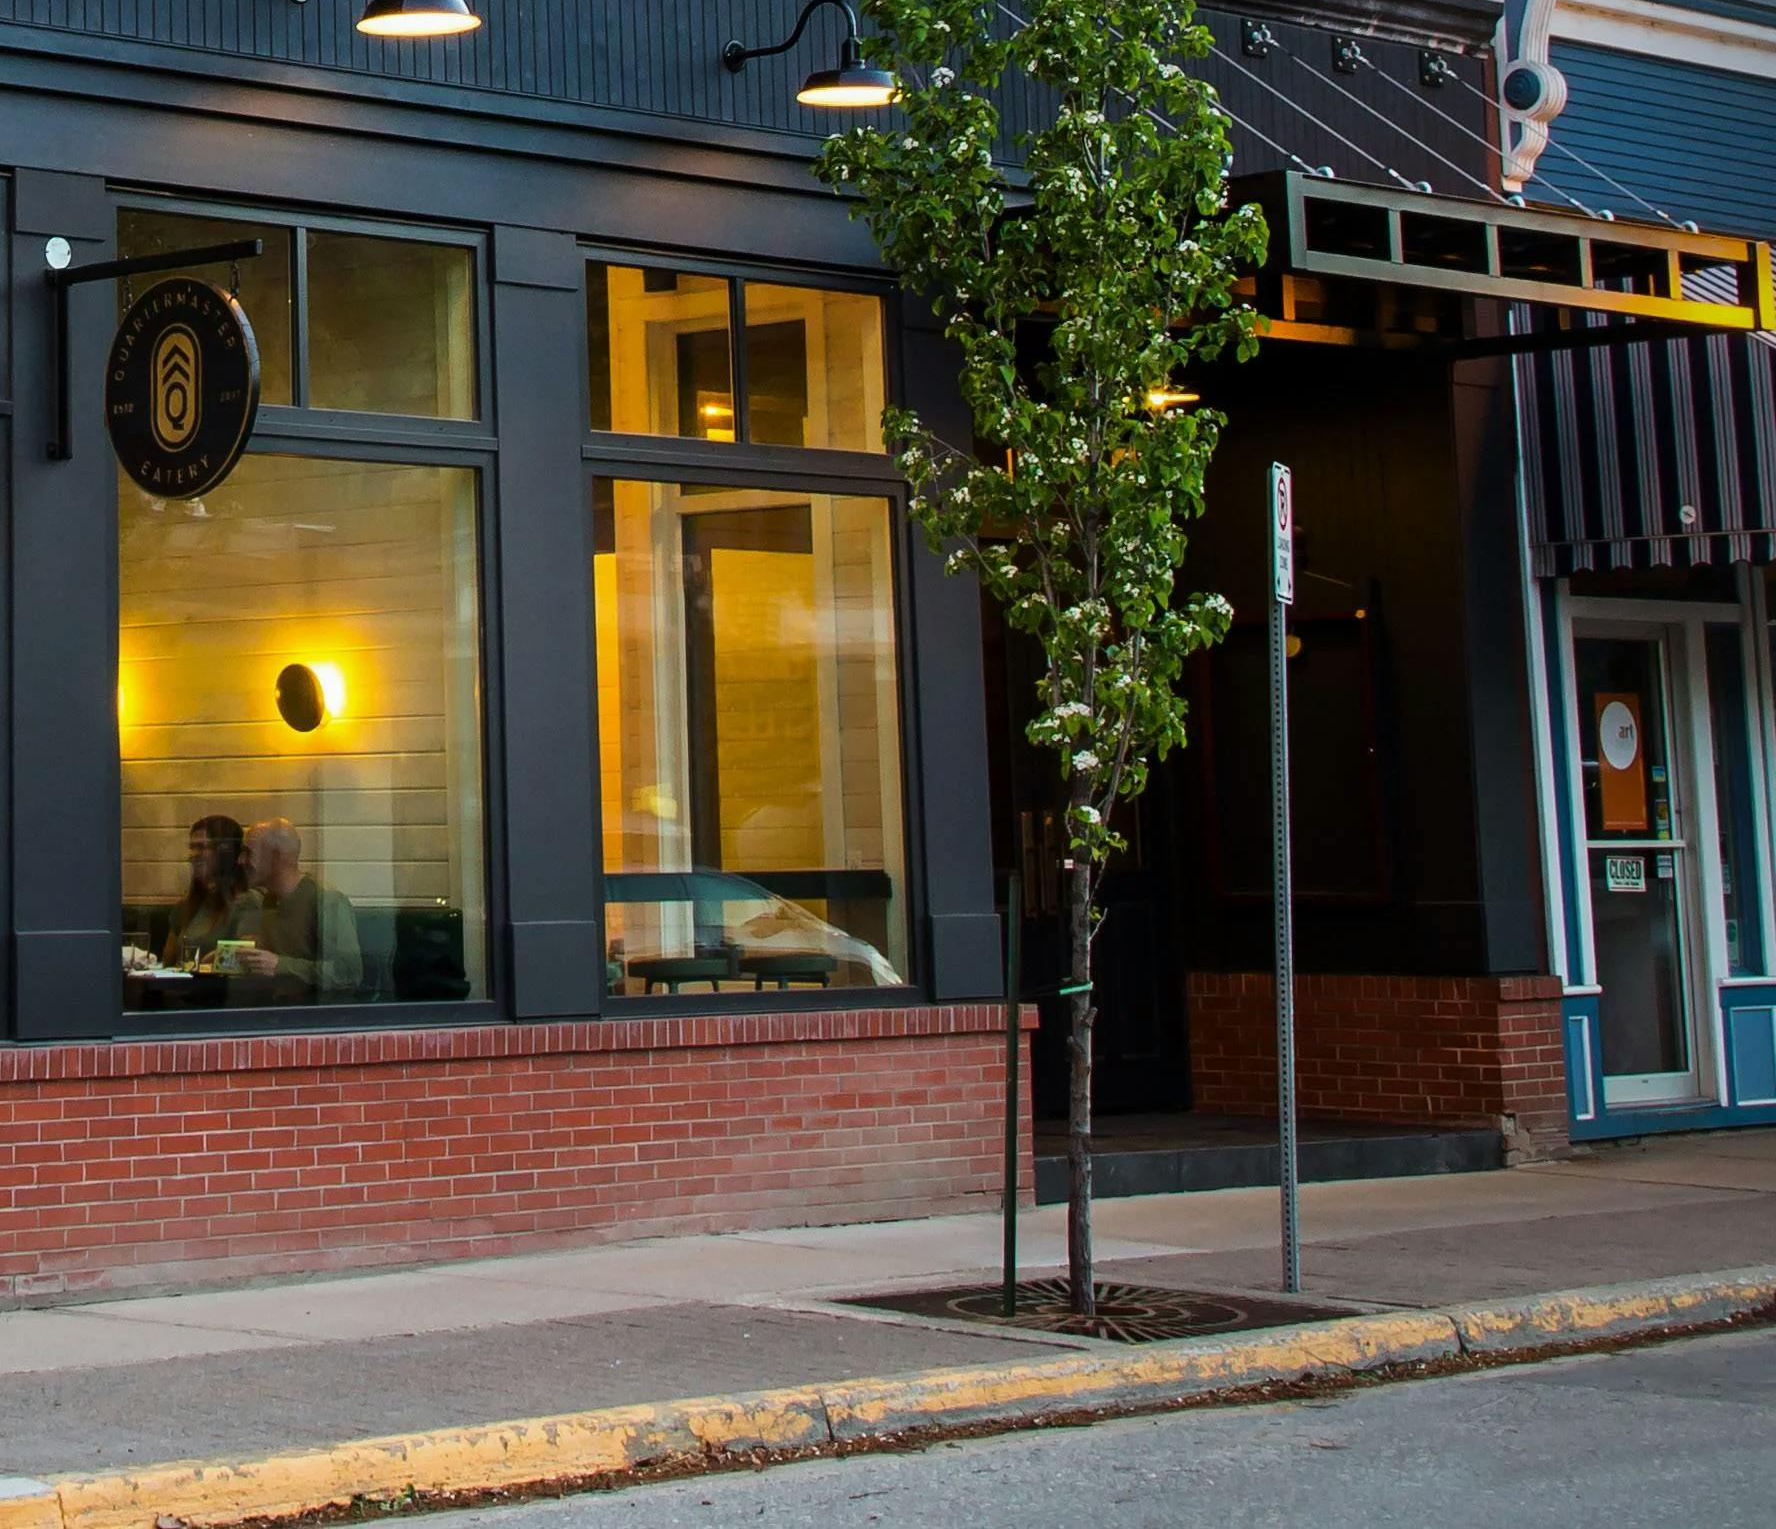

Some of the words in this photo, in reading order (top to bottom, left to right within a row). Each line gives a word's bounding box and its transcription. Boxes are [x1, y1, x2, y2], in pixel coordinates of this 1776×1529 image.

[115, 292, 235, 381] QUARTERMASTER
[165, 382, 188, 430] Q
[140, 453, 210, 484] EATERY
[1618, 724, 1634, 739] art
[1609, 859, 1642, 879] CLOSED
